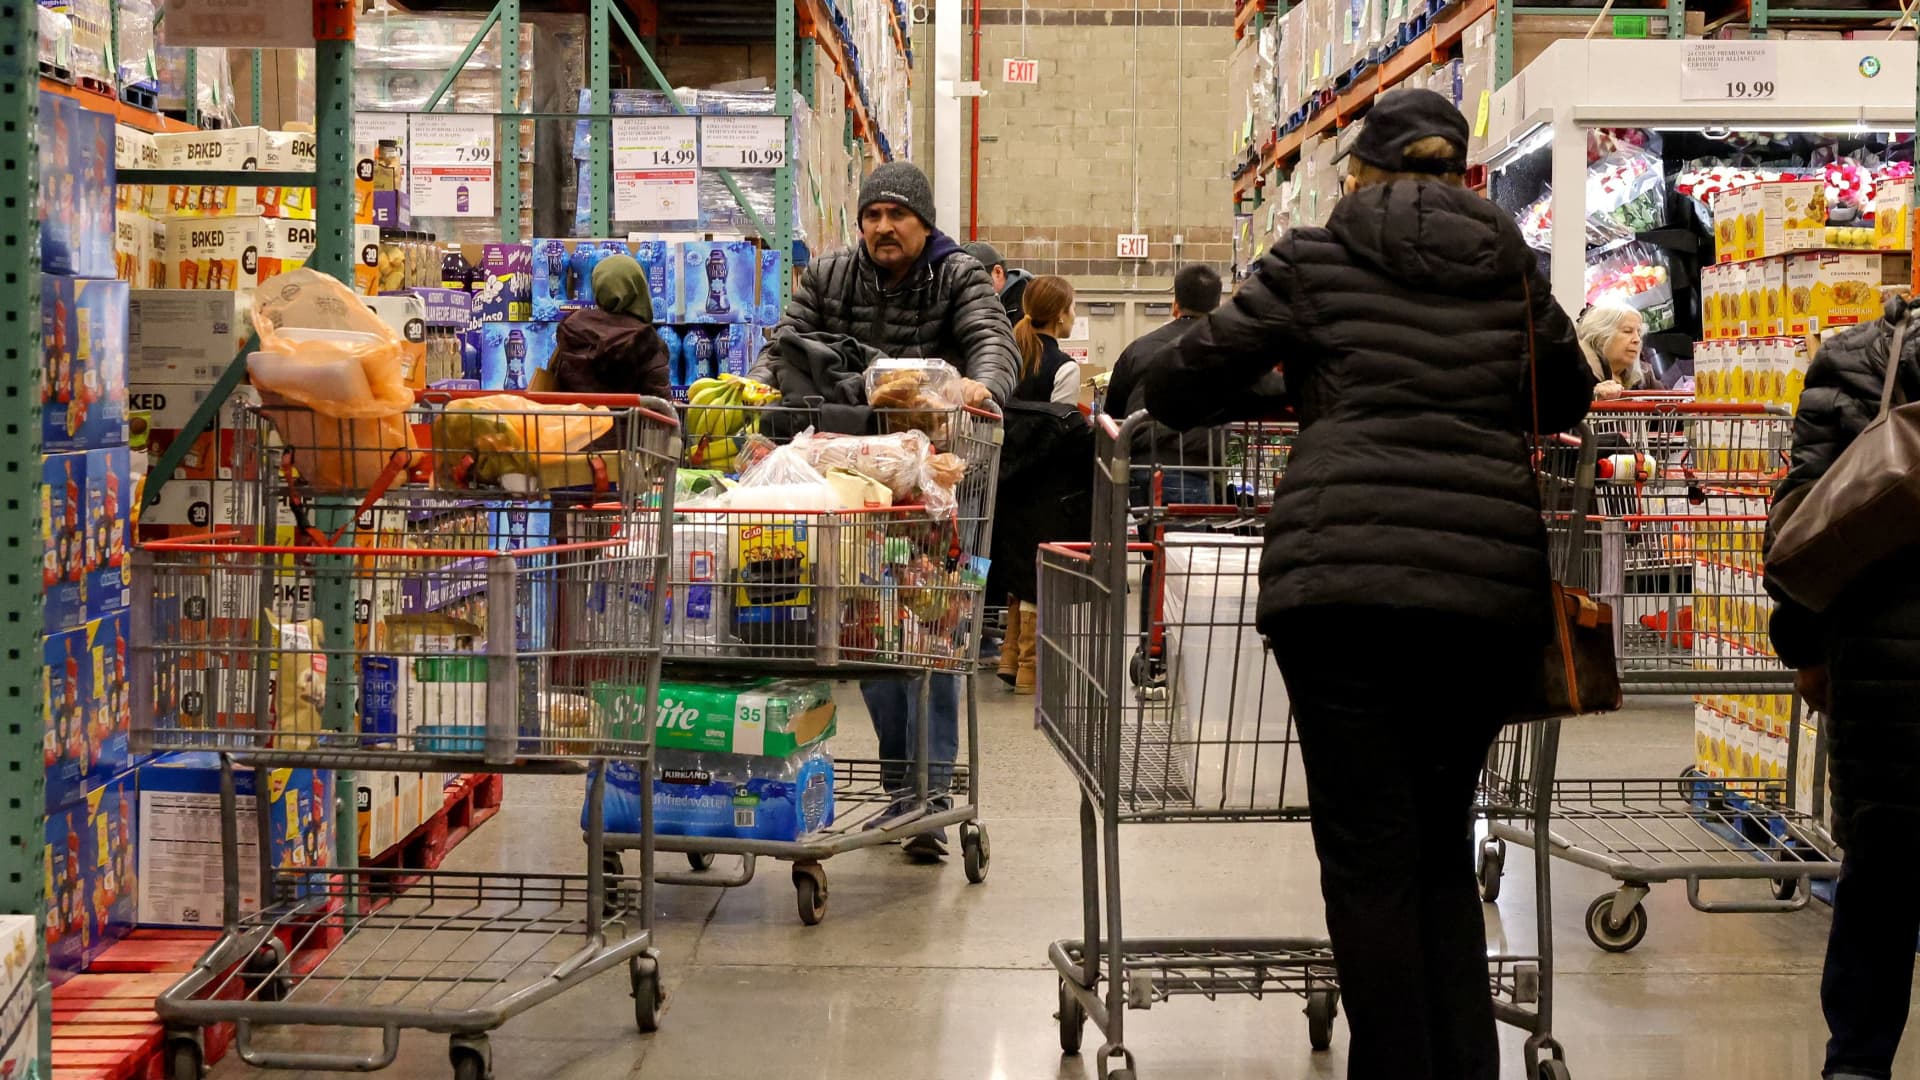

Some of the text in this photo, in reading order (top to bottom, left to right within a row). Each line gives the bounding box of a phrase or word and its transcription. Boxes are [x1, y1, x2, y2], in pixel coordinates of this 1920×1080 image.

[1008, 61, 1035, 81] EXIT
[1726, 81, 1775, 97] 19.99
[187, 142, 222, 160] BAKED
[456, 147, 490, 162] 7.99
[653, 150, 695, 165] 14.99
[741, 149, 783, 164] 10.99
[360, 162, 372, 173] 30
[192, 230, 224, 248] BAKED
[1121, 237, 1146, 256] EXIT
[245, 251, 257, 264] 30
[365, 248, 377, 258] 30
[408, 323, 422, 333] 30
[193, 507, 206, 518] 30
[739, 706, 761, 722] 35
[664, 770, 709, 780] KIRKLAND
[357, 791, 369, 804] 30
